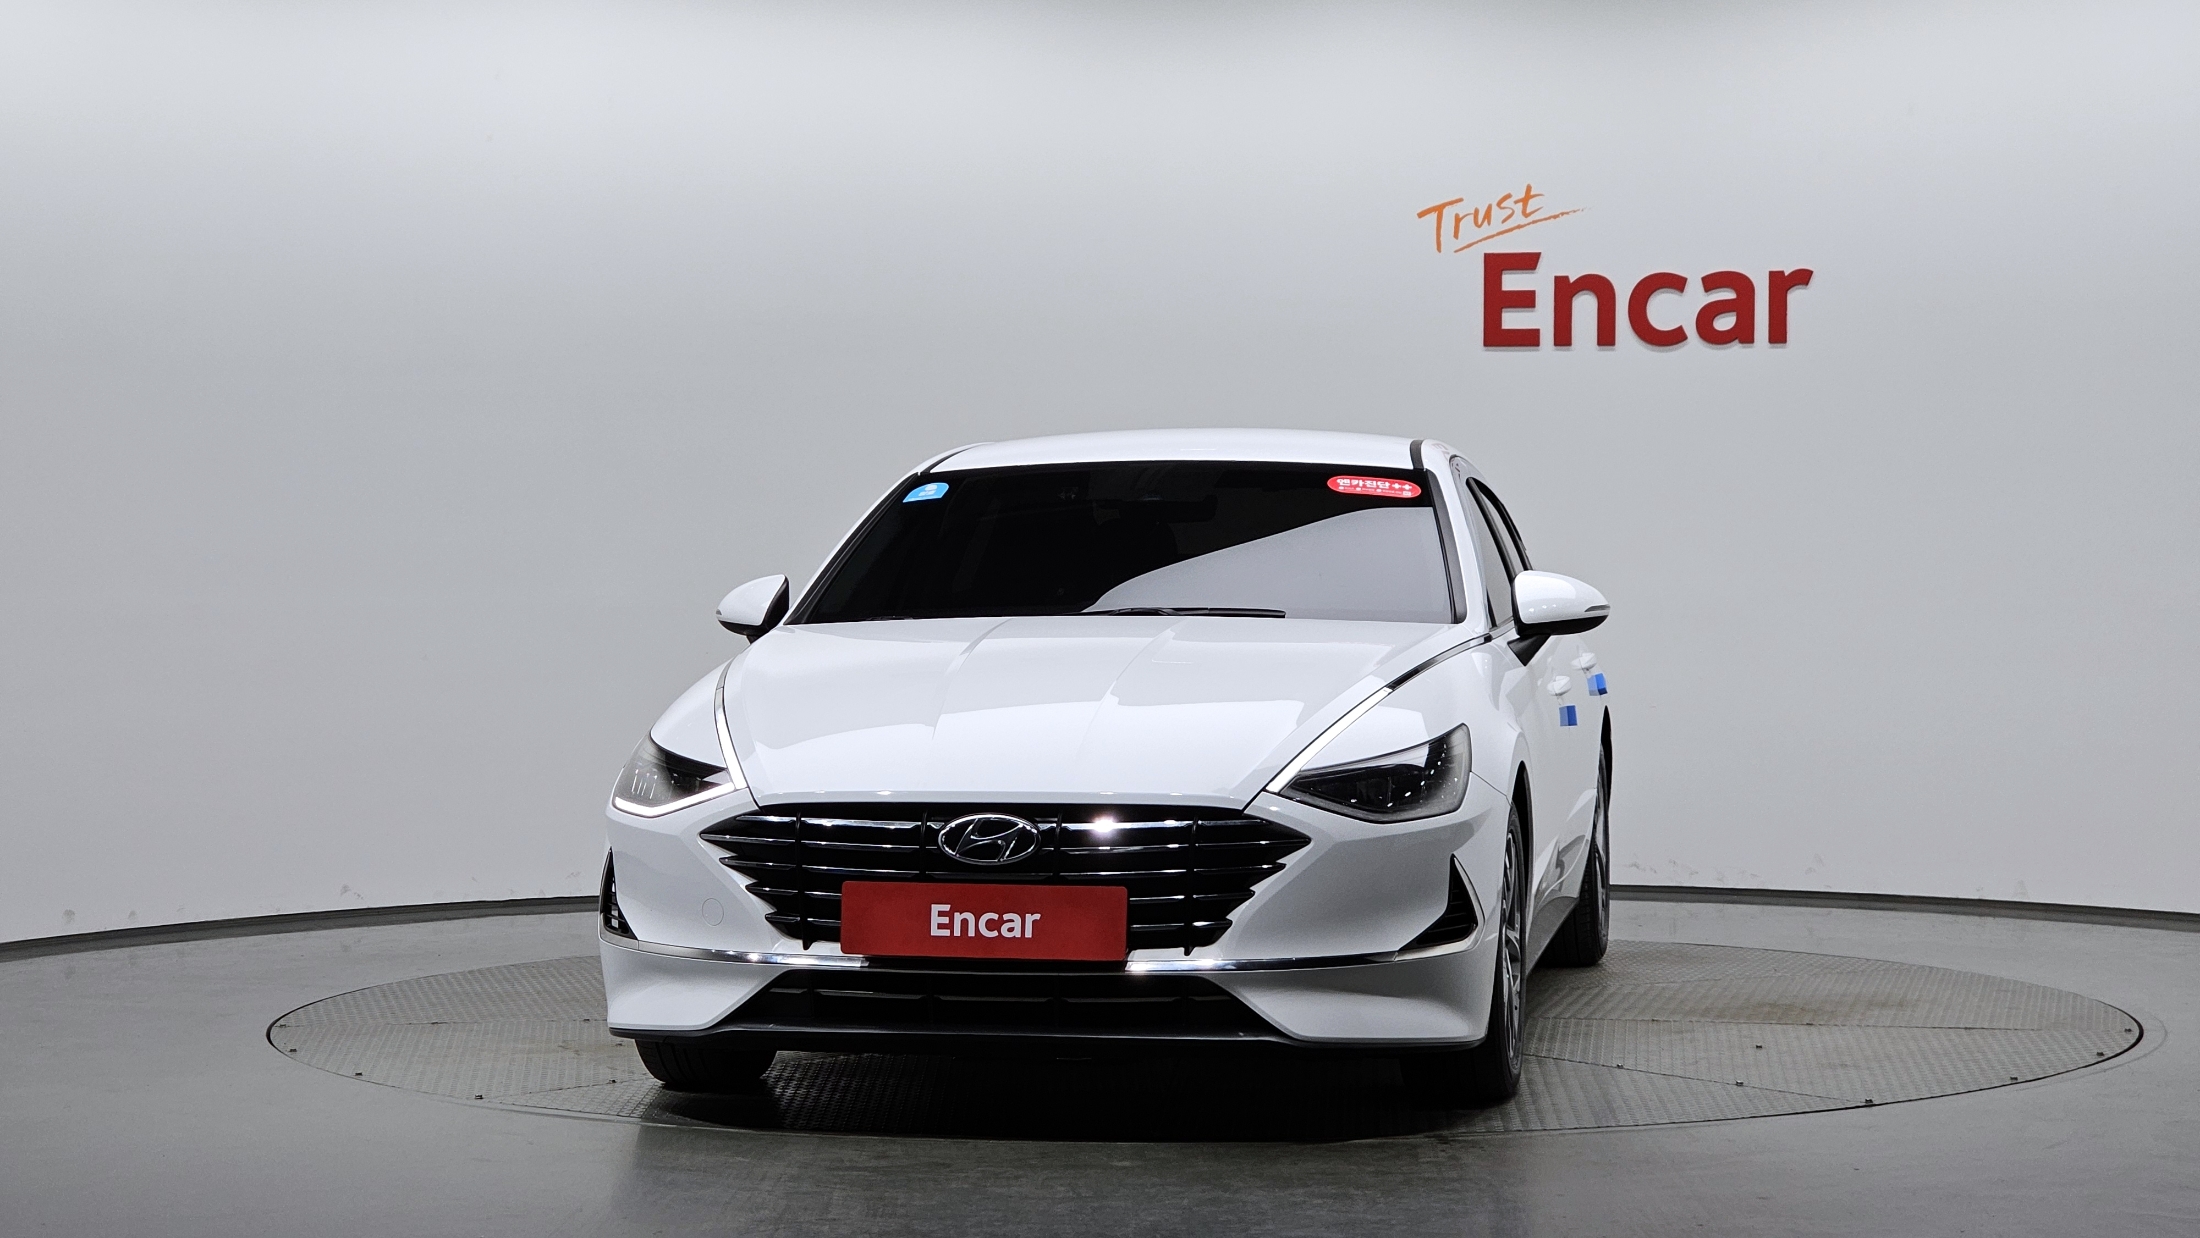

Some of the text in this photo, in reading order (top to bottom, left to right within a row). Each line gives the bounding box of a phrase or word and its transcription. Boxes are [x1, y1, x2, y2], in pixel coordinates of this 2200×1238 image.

[1417, 184, 1545, 253] Trust
[1483, 252, 1814, 347] Encar
[930, 904, 1041, 938] Encar
